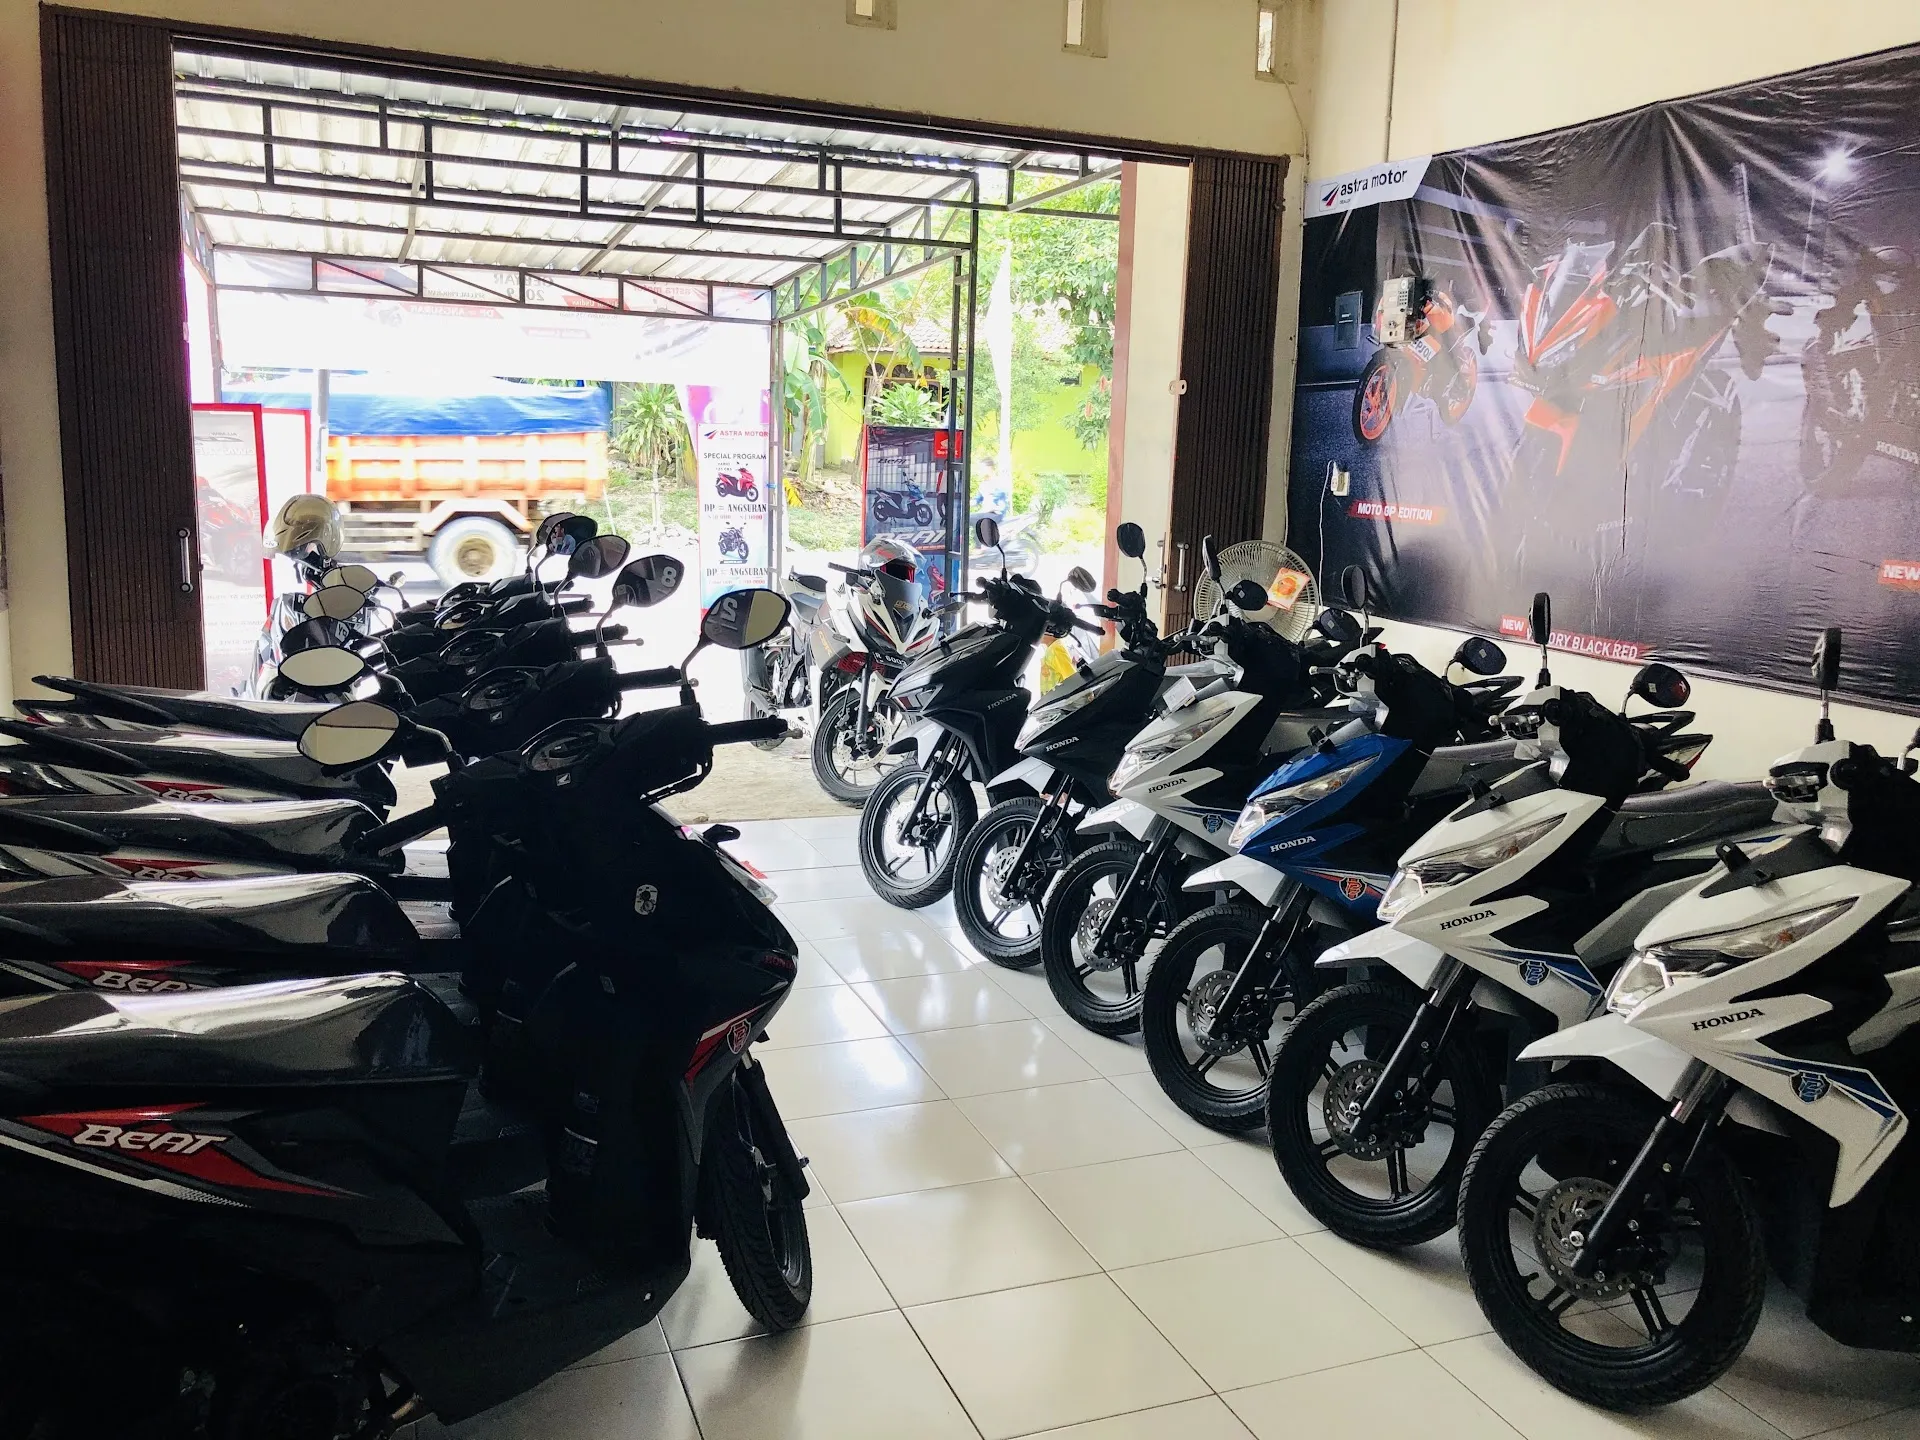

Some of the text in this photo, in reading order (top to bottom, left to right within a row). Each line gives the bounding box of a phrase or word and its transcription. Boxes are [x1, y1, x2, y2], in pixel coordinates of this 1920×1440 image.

[1340, 169, 1408, 196] astra motor
[703, 452, 731, 460] SPECIAL
[1876, 440, 1919, 465] HONDA
[704, 504, 715, 512] DP
[727, 503, 767, 513] ANGSURAN
[1357, 503, 1433, 521] MOTO GP EDITION
[706, 568, 718, 577] DP
[729, 567, 769, 577] ANGSURAN
[1882, 564, 1920, 581] NEW
[1502, 618, 1638, 660] NEW VORY BLACK RED
[987, 693, 1018, 711] HONDA
[1045, 736, 1080, 752] HONDA
[1148, 778, 1188, 794] HONDA
[1269, 836, 1317, 853] HONDA
[1439, 909, 1497, 931] HONDA
[1691, 1008, 1766, 1031] HONDA
[73, 1122, 228, 1155] BeAT
